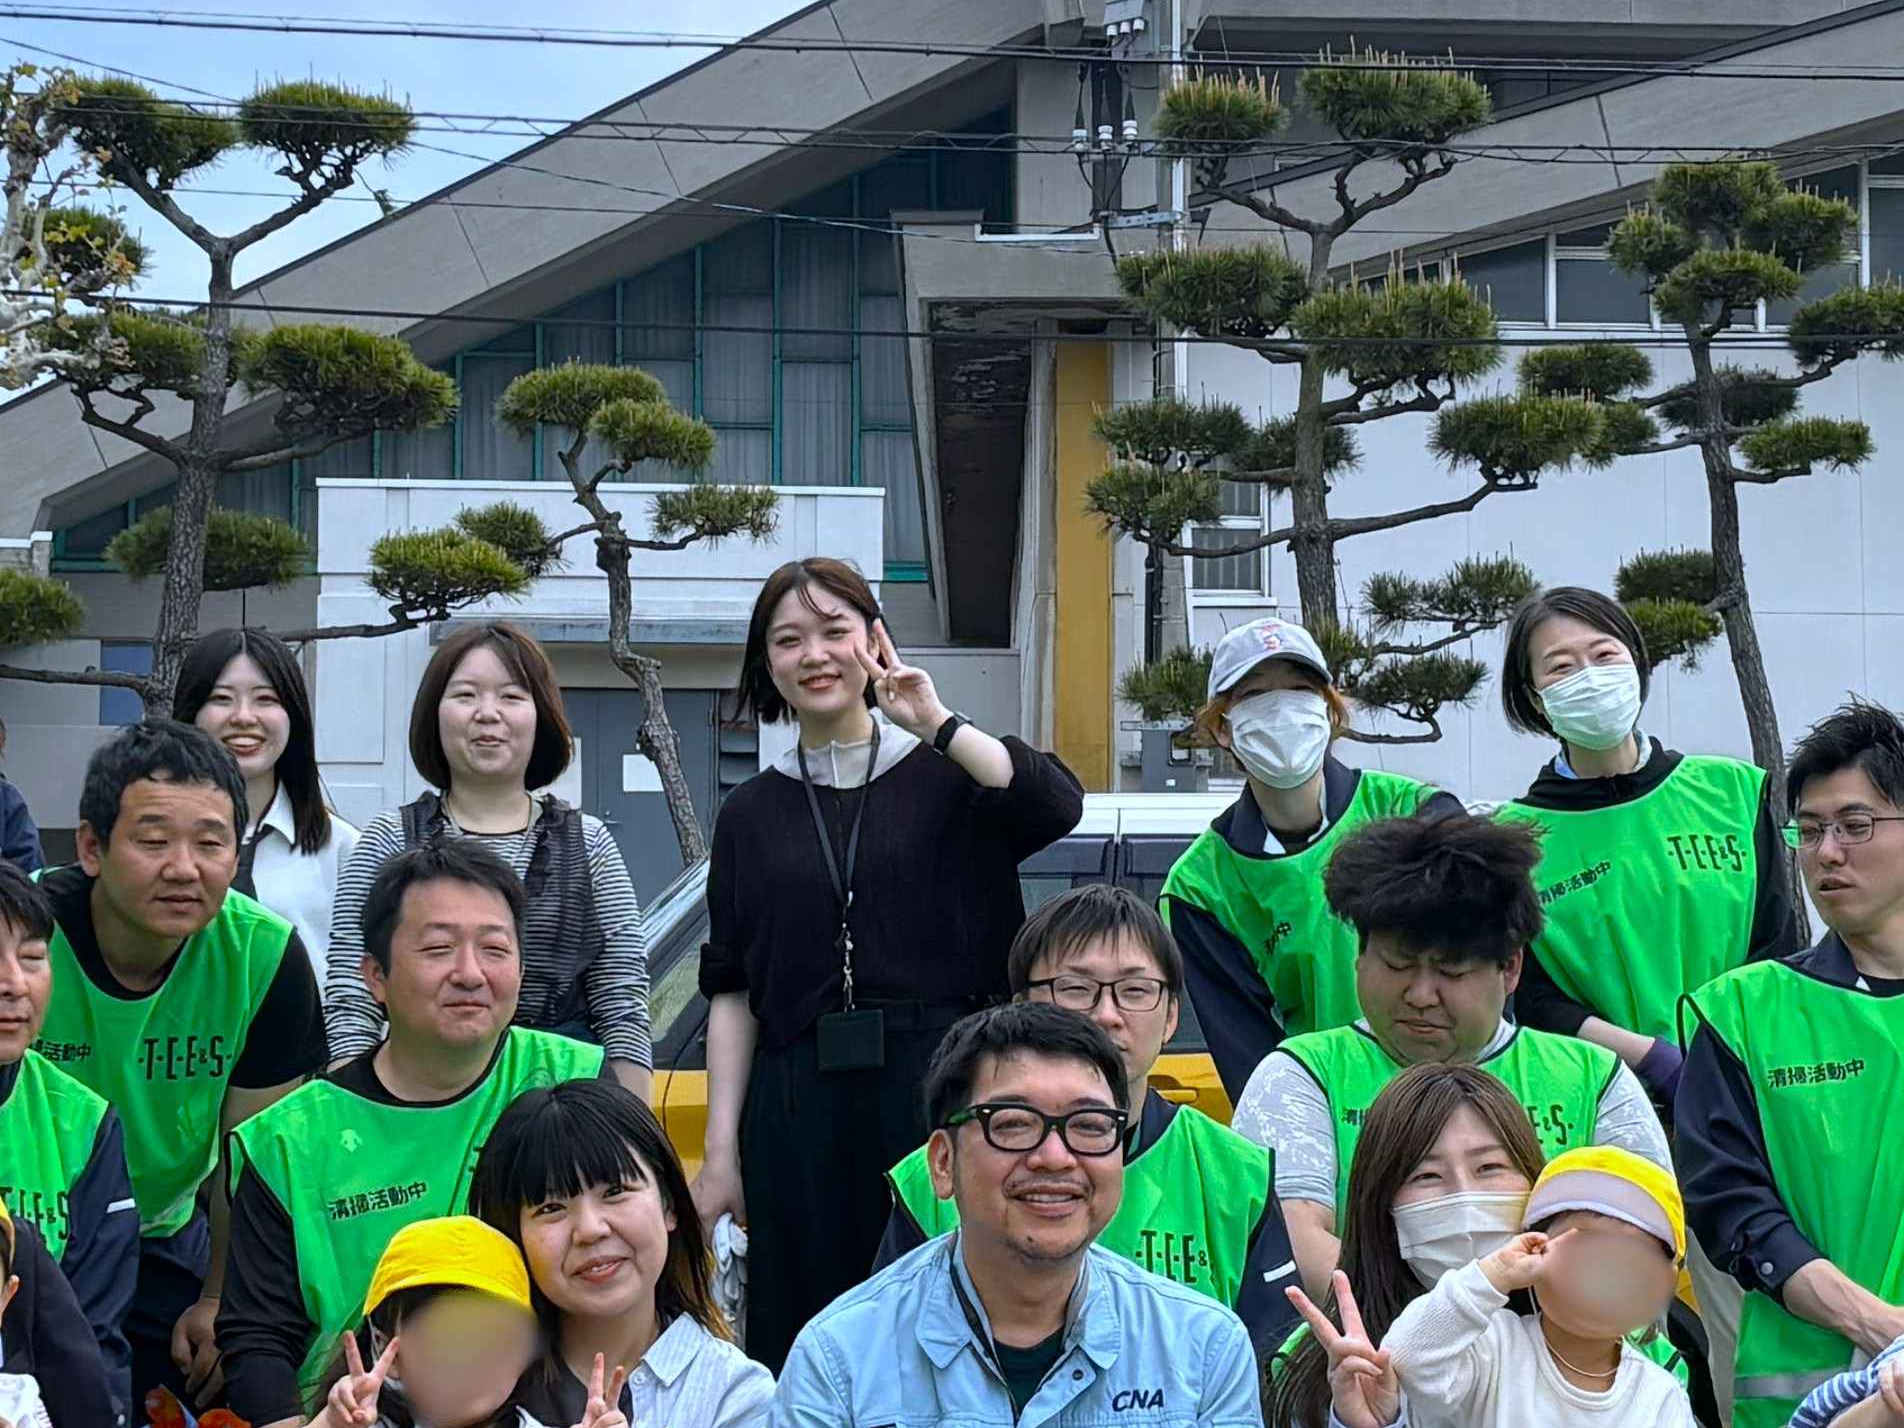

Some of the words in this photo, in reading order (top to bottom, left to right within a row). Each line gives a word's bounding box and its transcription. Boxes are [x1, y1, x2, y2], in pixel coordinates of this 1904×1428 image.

[1767, 1058, 1865, 1089] 清掃活動中
[327, 1180, 428, 1221] 清掃活動中
[1112, 1388, 1165, 1413] CNA
